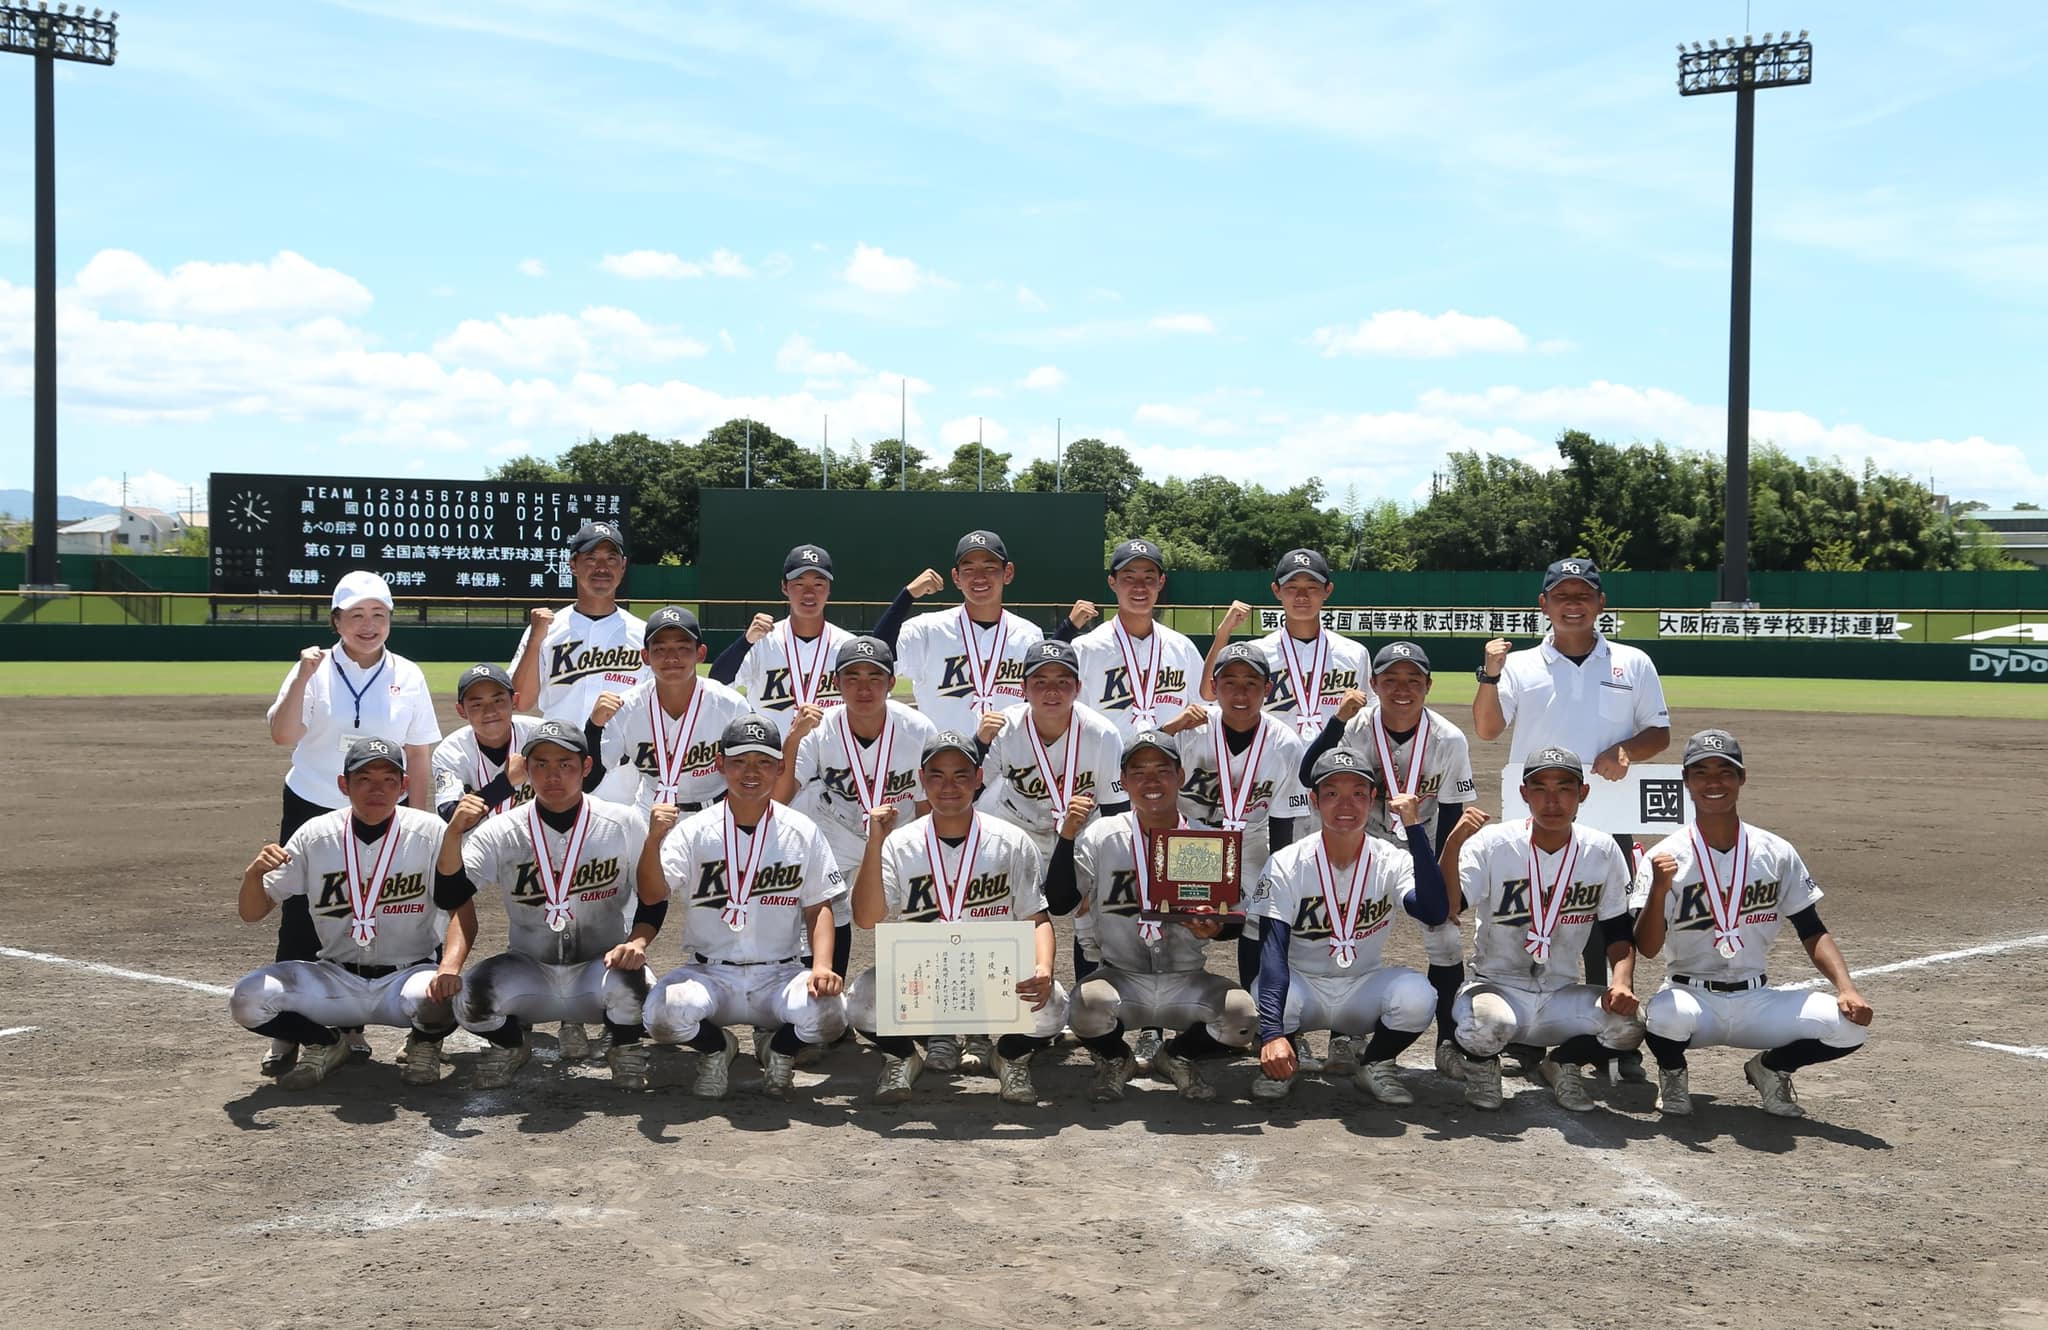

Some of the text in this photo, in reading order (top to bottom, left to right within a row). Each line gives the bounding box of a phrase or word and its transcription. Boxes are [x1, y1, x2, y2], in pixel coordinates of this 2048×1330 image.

[306, 486, 353, 499] TEAM
[366, 488, 371, 500] 1
[380, 488, 389, 501] 2
[395, 488, 404, 501] 3
[410, 489, 419, 501] 4
[425, 489, 434, 502] 5
[440, 490, 449, 502] 6
[455, 490, 464, 503] 7
[470, 491, 478, 503] 8
[485, 491, 493, 503] 9
[499, 491, 509, 504] 10
[517, 492, 526, 504] R
[534, 492, 544, 505] H
[551, 493, 561, 505] E
[363, 501, 374, 517] 0
[379, 502, 389, 518] 0
[394, 502, 405, 518] 0
[409, 503, 420, 518] 0
[424, 503, 435, 519] 0
[439, 503, 450, 519] 0
[454, 504, 464, 520] 0
[469, 504, 479, 520] 0
[484, 504, 494, 520] 0
[516, 505, 526, 521] 0
[534, 506, 544, 522] 2
[553, 507, 559, 522] 1
[302, 521, 357, 534] あべの翔学
[363, 521, 374, 537] 0
[379, 521, 389, 537] 0
[394, 522, 404, 538] 0
[409, 522, 420, 538] 0
[424, 522, 434, 538] 0
[439, 523, 449, 539] 0
[457, 523, 462, 539] 1
[469, 524, 479, 539] 0
[484, 524, 494, 540] X
[518, 525, 523, 540] 1
[534, 525, 543, 541] 4
[551, 526, 561, 541] 0
[215, 547, 223, 555] B
[215, 557, 223, 566] S
[256, 548, 264, 556] H
[305, 543, 366, 559] 第67回
[255, 558, 263, 567] E
[381, 571, 427, 586] の翔学
[1659, 614, 1896, 635] 大阪府高等学校野球連盟
[551, 640, 643, 678] Kokoku
[1969, 653, 2048, 677] DyDo
[937, 654, 1025, 690] Koku
[1100, 666, 1187, 703] Koku
[1266, 668, 1359, 705] Koku
[633, 737, 722, 773] Koku
[1640, 779, 1685, 825] 國
[511, 856, 620, 897] Koku
[691, 859, 804, 900] Koku
[314, 872, 426, 909] Koku
[759, 895, 800, 906] GAKUEN
[901, 873, 1011, 914] Koku
[1674, 878, 1781, 924] Koku
[382, 903, 425, 915] GAKUEN
[970, 904, 1010, 918] GAKUEN
[1292, 893, 1393, 932] Koku
